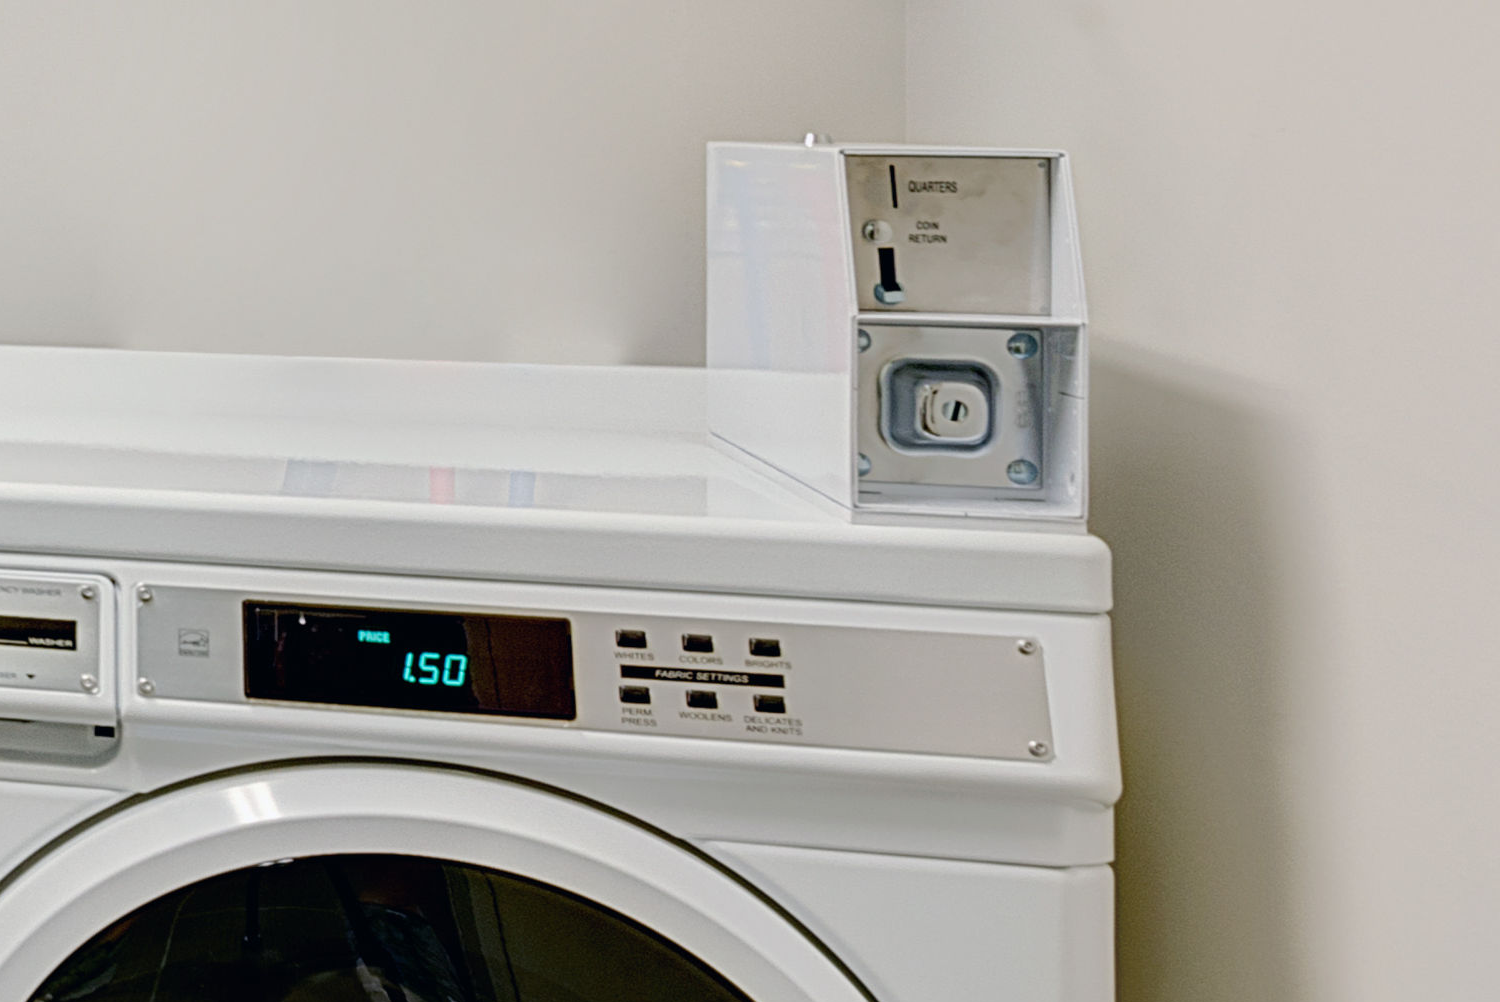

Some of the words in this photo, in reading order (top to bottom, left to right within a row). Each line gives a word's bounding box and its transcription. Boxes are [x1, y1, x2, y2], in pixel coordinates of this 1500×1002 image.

[908, 180, 958, 193] QUARTERS
[916, 220, 940, 230] COIN
[908, 233, 948, 244] RETURN
[28, 636, 73, 647] WASHER
[357, 629, 391, 644] PRICE
[613, 651, 655, 662] WHITES
[678, 655, 723, 666] COLORS
[403, 651, 468, 687] 1.50
[744, 659, 792, 670] BRIGHTS
[654, 669, 694, 681] FABRIC
[696, 671, 750, 684] SETTINGS
[621, 706, 653, 717] PERM
[678, 711, 733, 722] WOOLENS
[620, 717, 658, 728] PRESS
[743, 715, 803, 727] DELICATES
[745, 725, 767, 735] AND
[770, 727, 803, 736] KNITS
